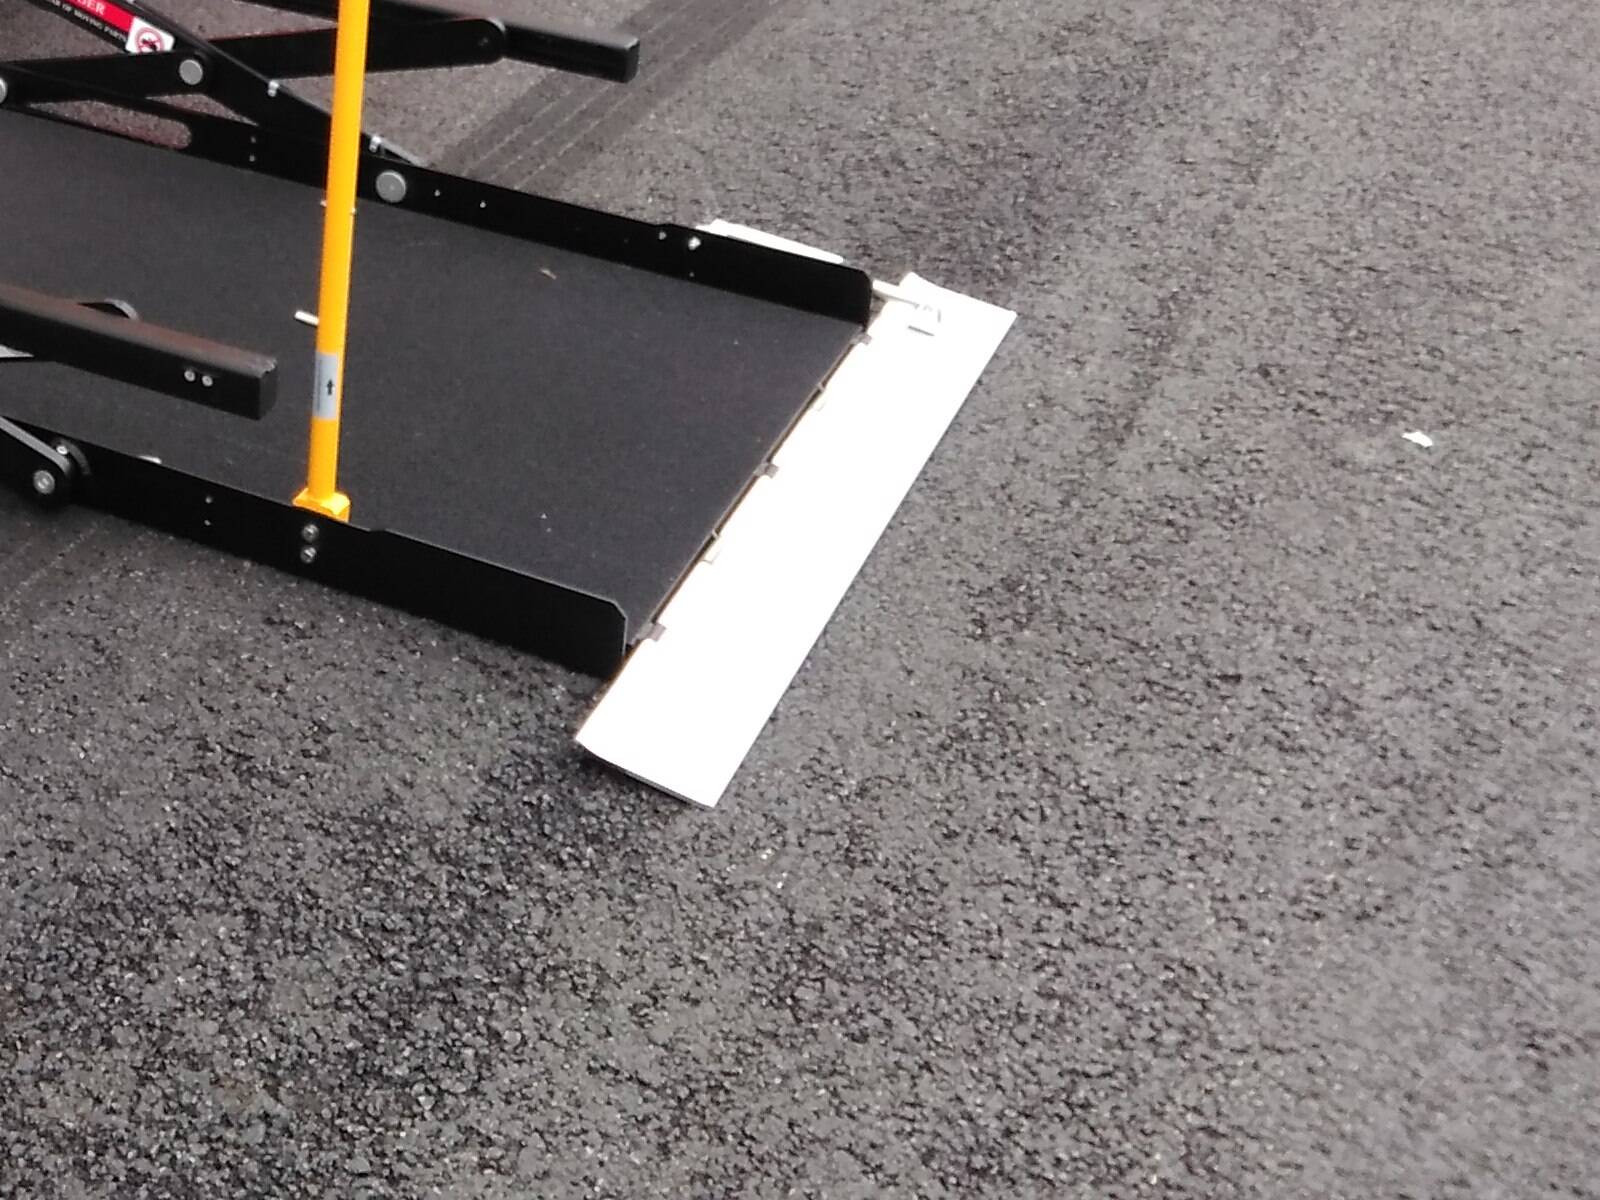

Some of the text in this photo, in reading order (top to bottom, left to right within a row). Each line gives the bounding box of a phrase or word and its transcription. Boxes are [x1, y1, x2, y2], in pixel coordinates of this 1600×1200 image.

[62, 2, 72, 13] OF
[73, 8, 103, 30] MOVING
[103, 25, 127, 42] PARTS
